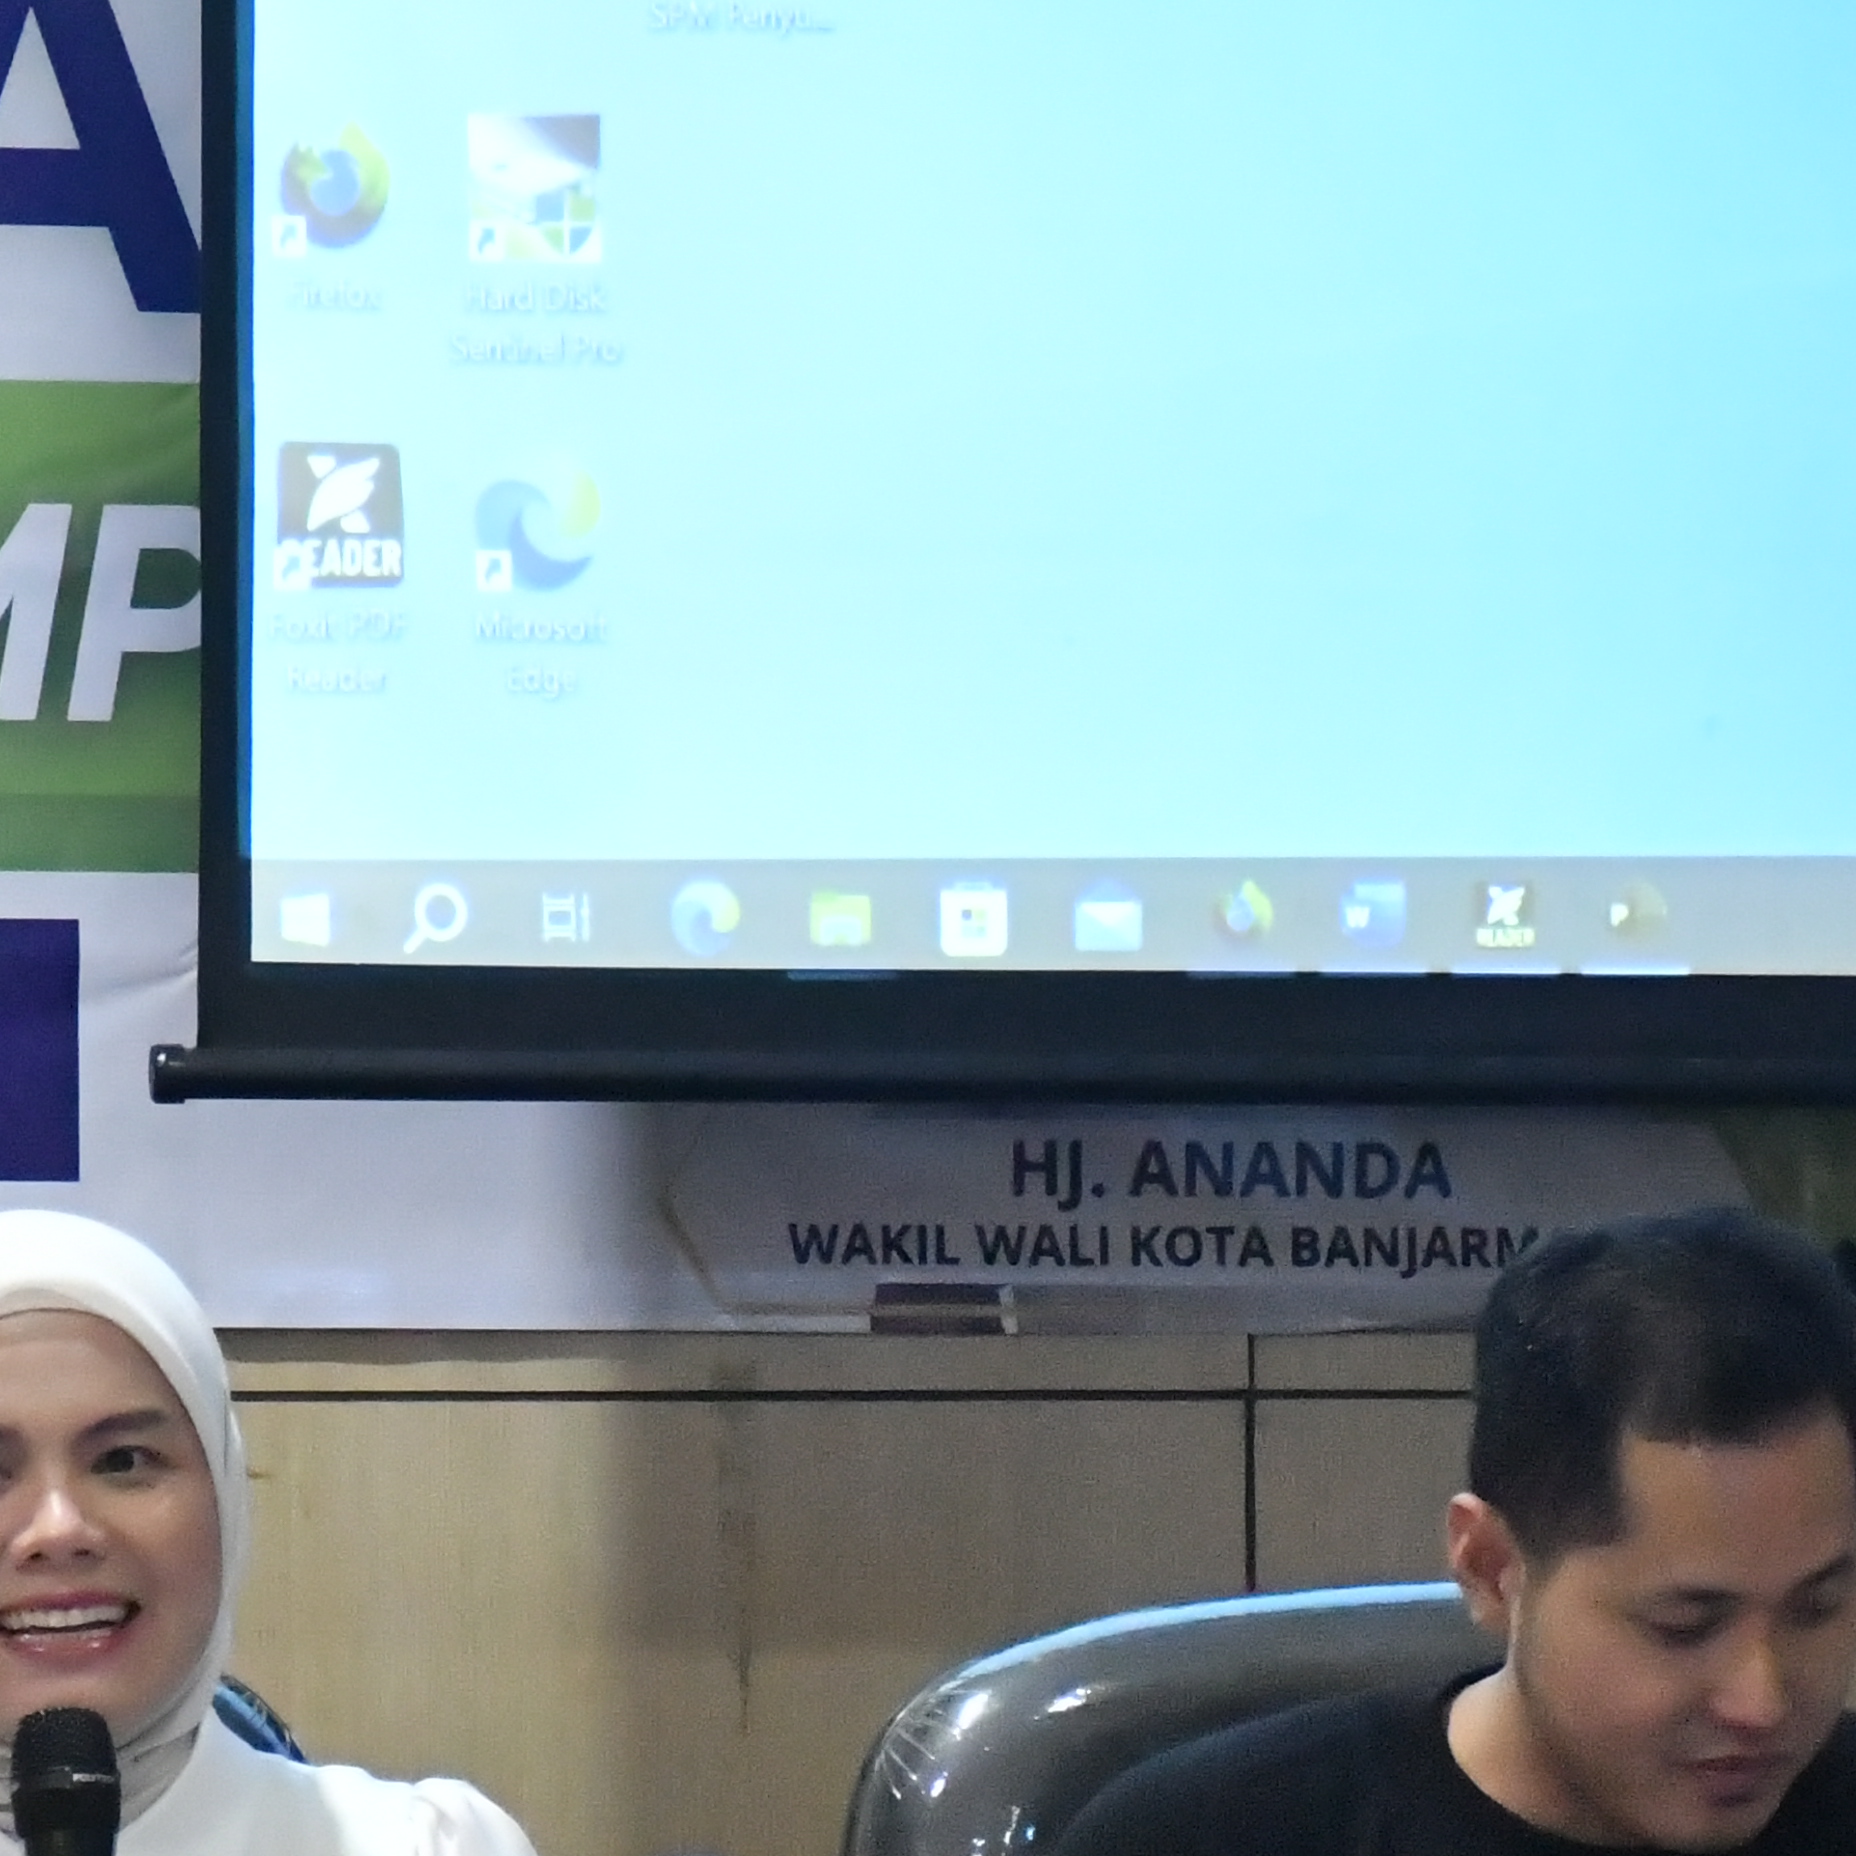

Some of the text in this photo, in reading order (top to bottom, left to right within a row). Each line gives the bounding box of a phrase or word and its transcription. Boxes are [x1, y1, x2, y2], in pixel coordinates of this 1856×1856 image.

[463, 283, 608, 313] Hard Disk
[450, 334, 624, 364] Sentinel Pro
[474, 614, 609, 644] Microsoft
[287, 664, 387, 694] Reader
[506, 665, 578, 700] Edge
[1011, 1139, 1454, 1211] HJ. ANANDA
[786, 1220, 962, 1267] WAKIL
[973, 1222, 1111, 1268] WALI
[1129, 1223, 1276, 1268] KOTA
